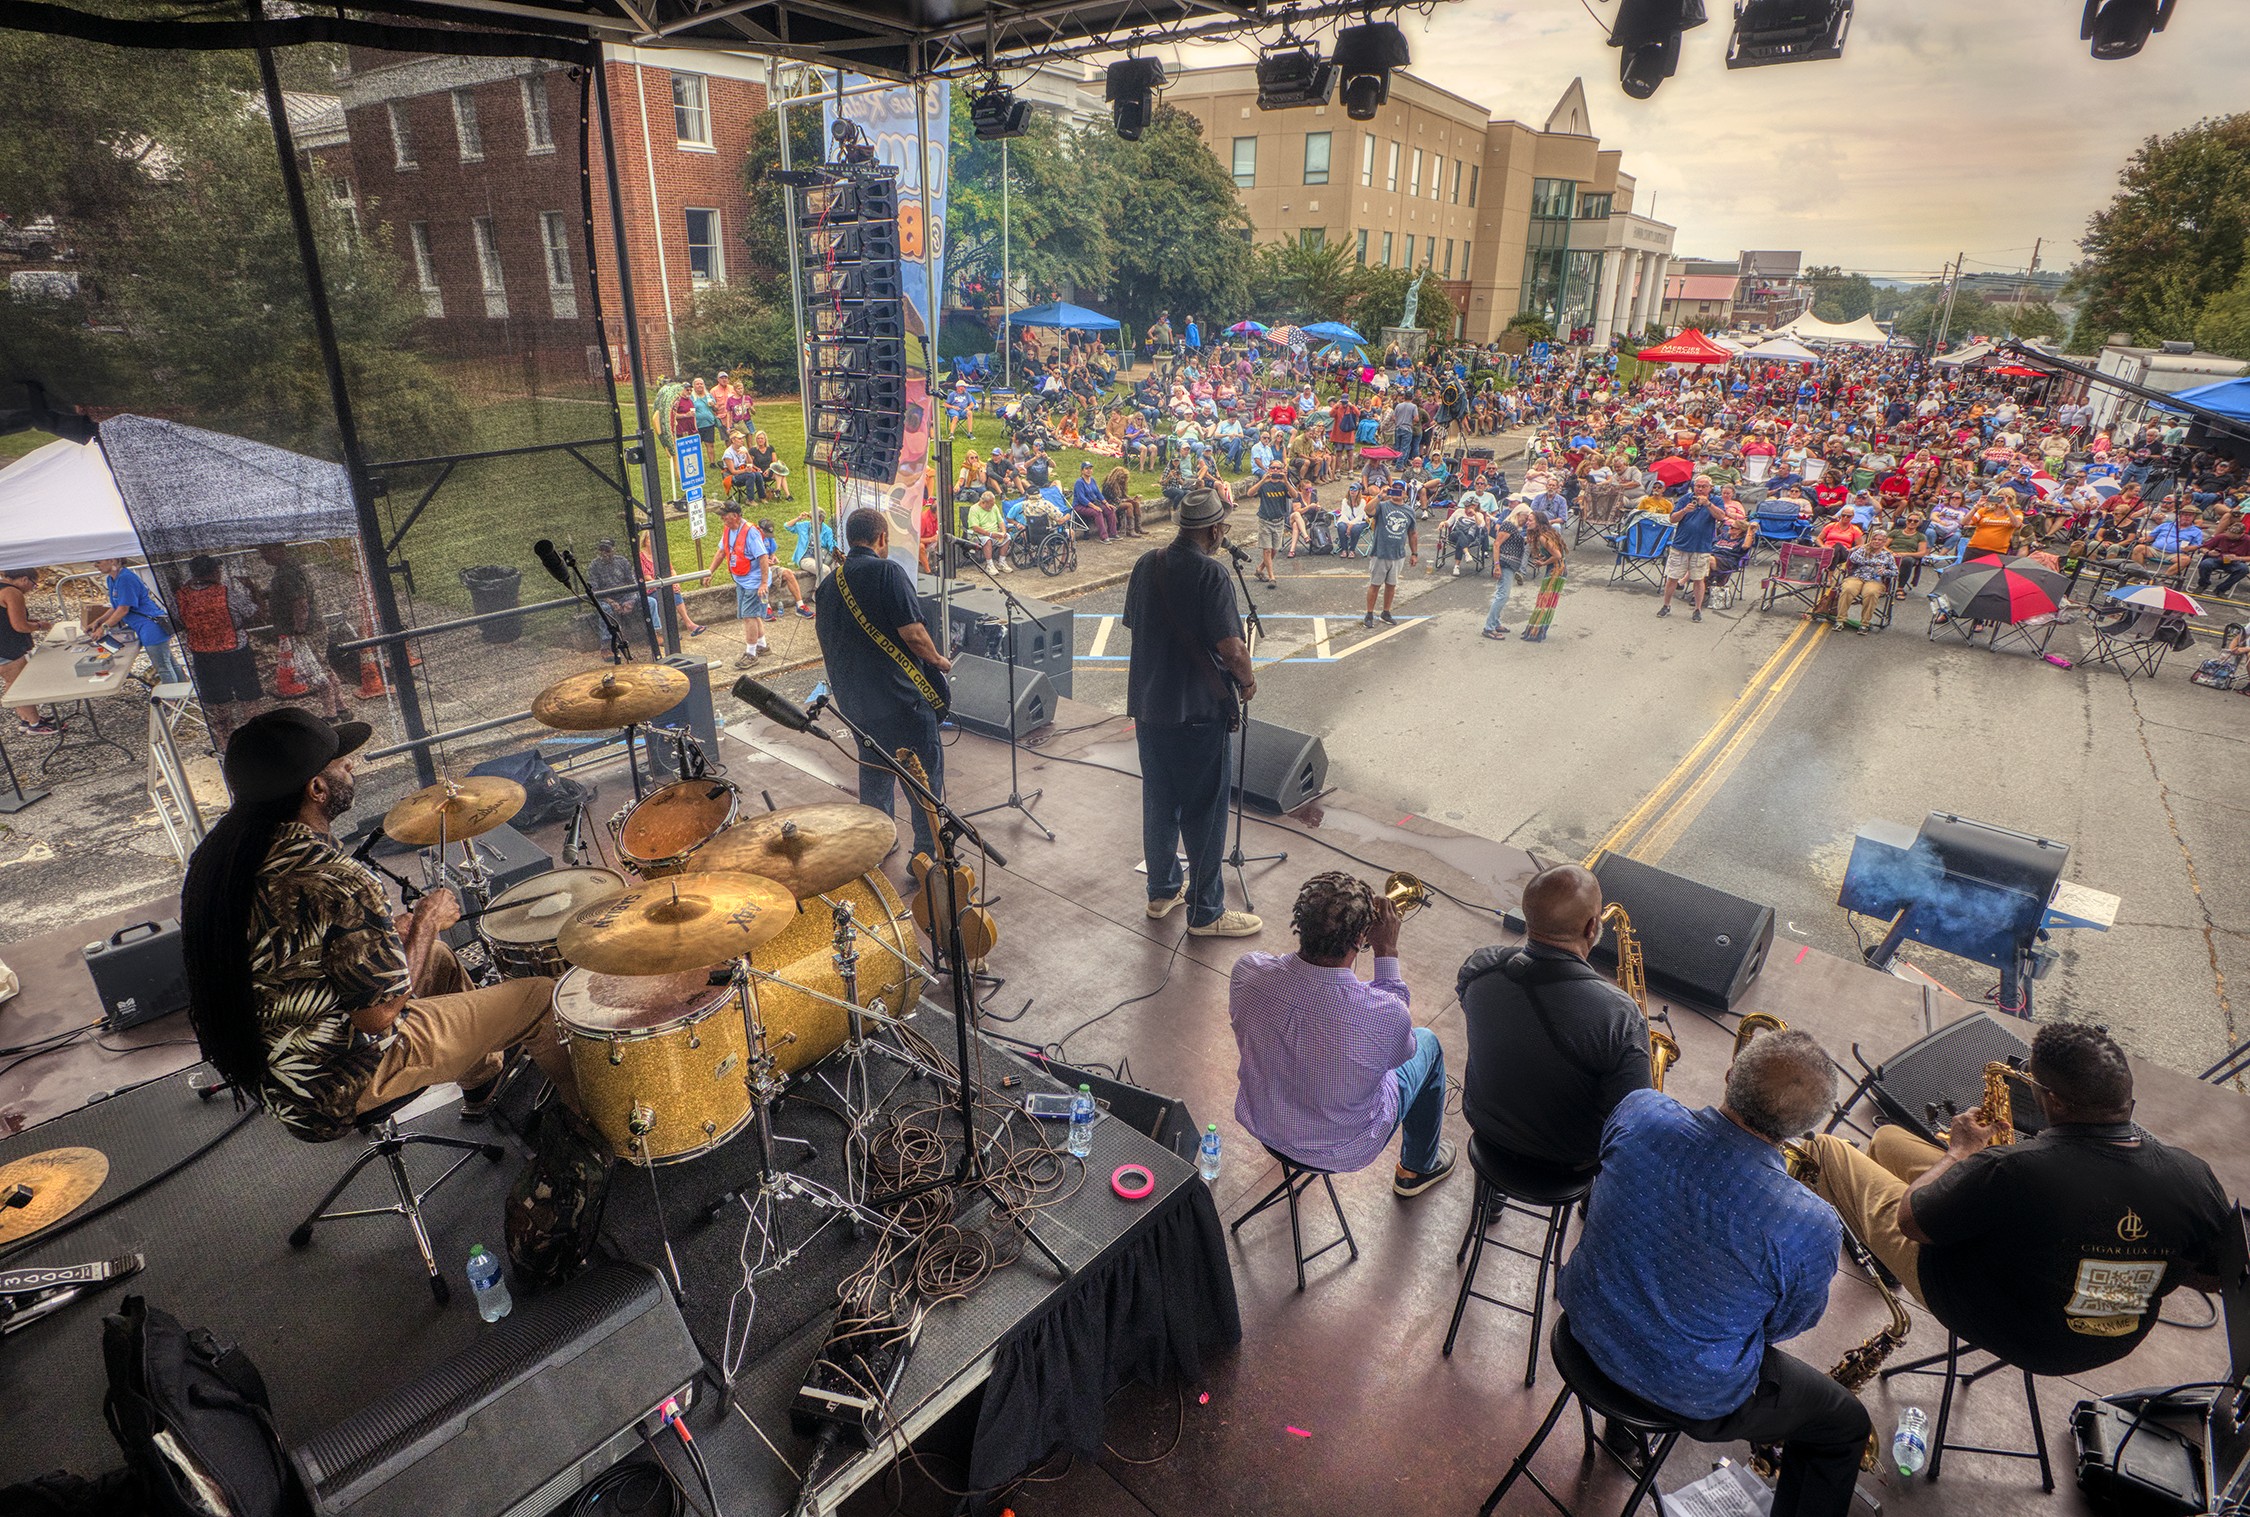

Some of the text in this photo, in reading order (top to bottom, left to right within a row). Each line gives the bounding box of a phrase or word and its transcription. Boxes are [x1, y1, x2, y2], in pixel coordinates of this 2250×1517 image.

[836, 573, 859, 615] POLICE
[857, 613, 882, 641] LINE
[880, 638, 895, 654] DO
[895, 652, 915, 673] NOT
[592, 894, 642, 929] SABIAN
[2081, 1244, 2121, 1255] CIGAR
[2126, 1247, 2148, 1255] LUX
[2116, 1318, 2130, 1328] ME
